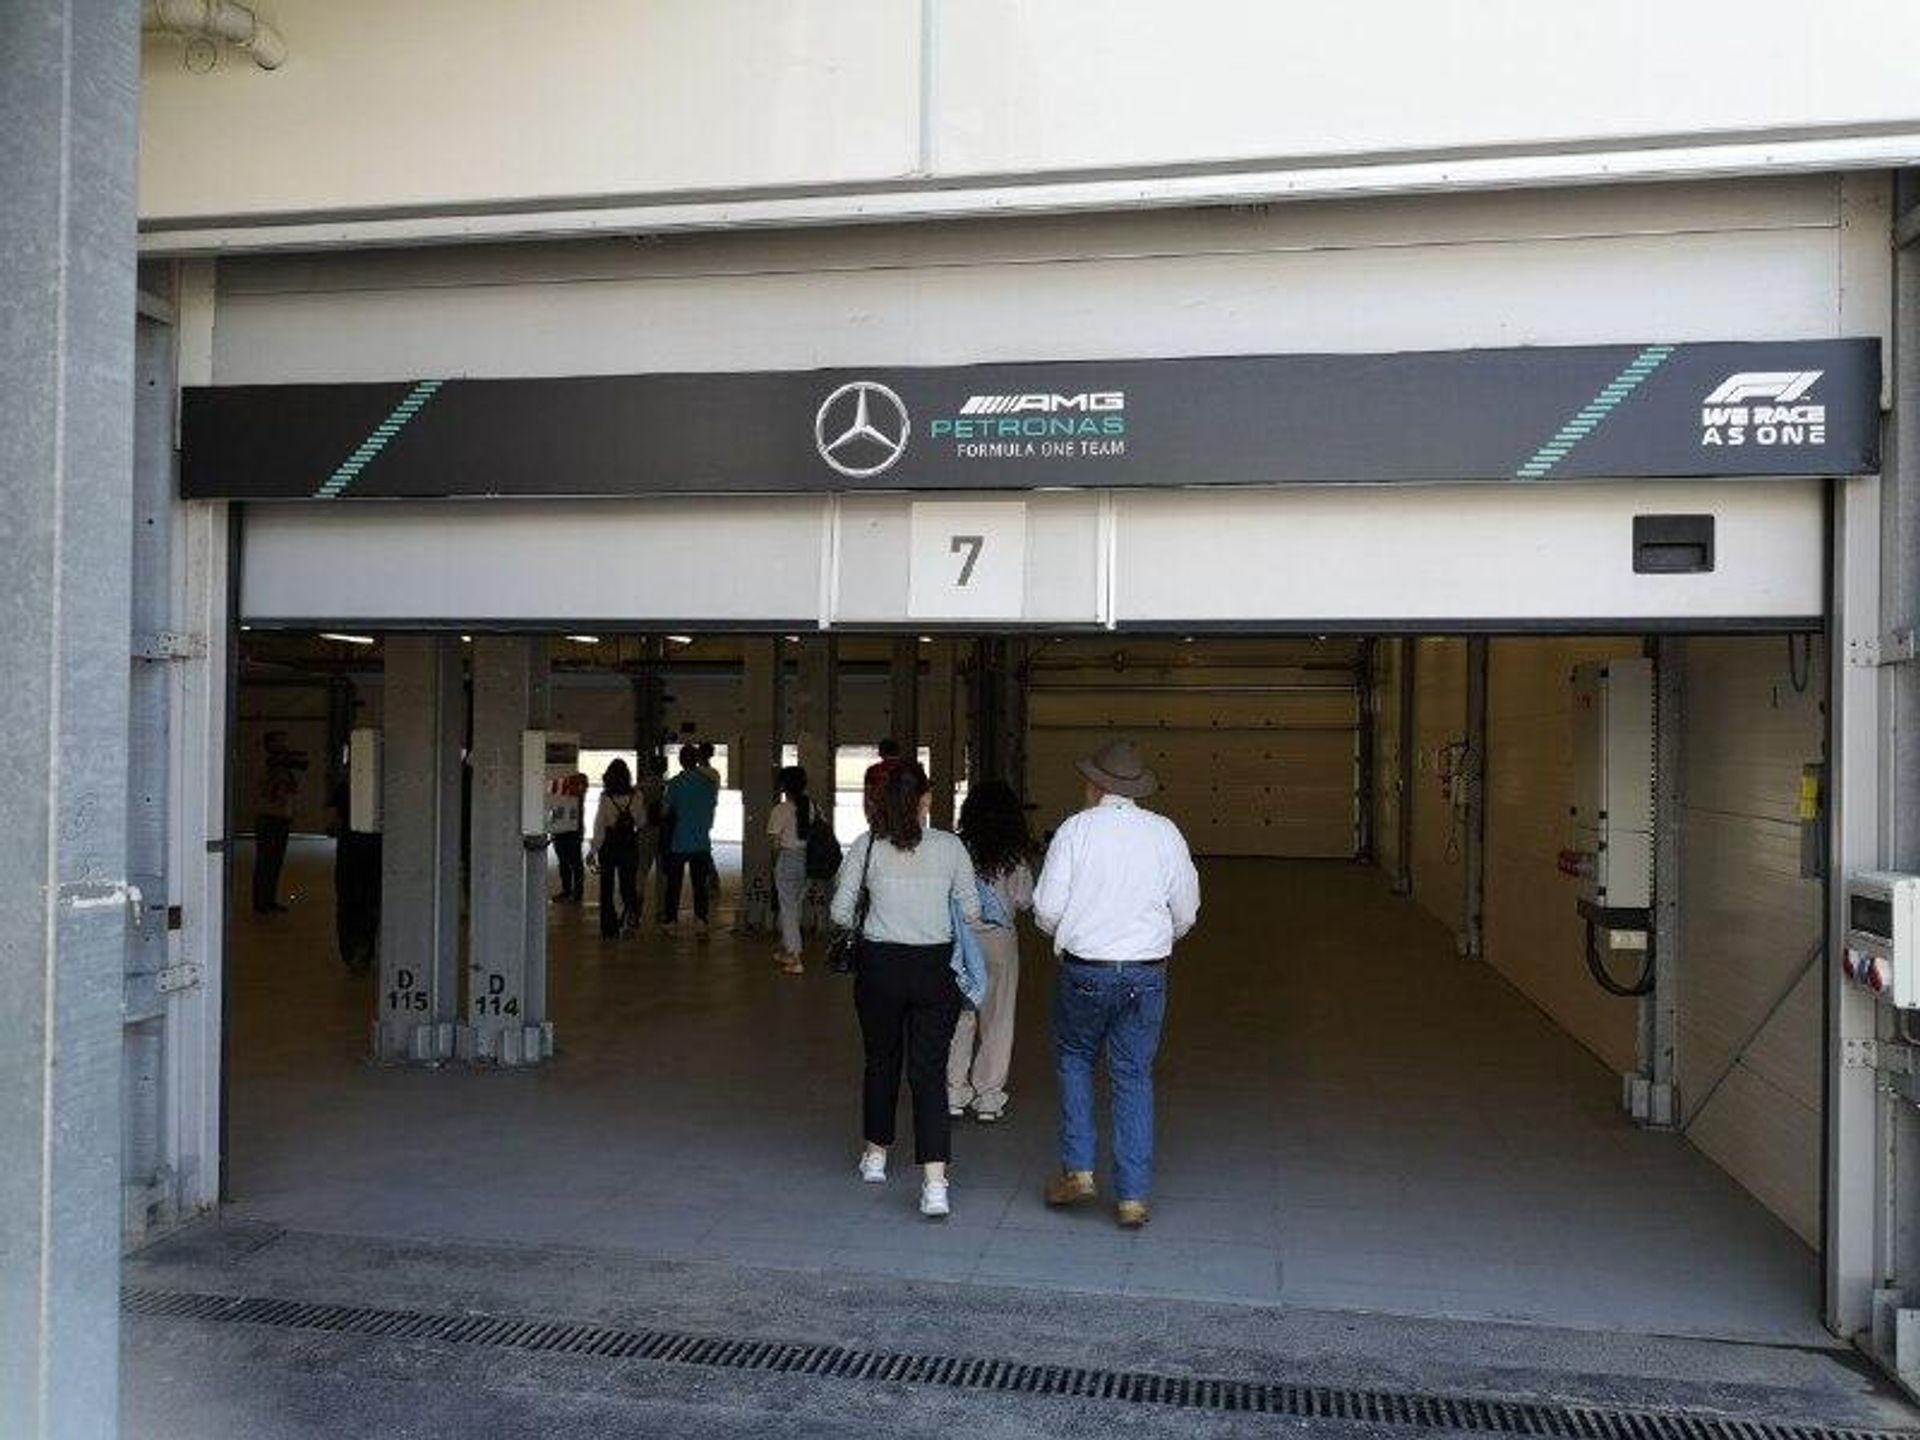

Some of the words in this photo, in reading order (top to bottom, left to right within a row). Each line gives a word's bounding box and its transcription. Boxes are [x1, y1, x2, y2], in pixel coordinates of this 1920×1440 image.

[1011, 391, 1125, 413] AMG
[1703, 407, 1749, 426] WE
[1753, 405, 1825, 424] RACE
[930, 417, 1125, 438] PETRONAS
[1702, 426, 1745, 445] AS
[1756, 425, 1825, 445] ONE
[957, 442, 1036, 458] FORMULA
[1041, 442, 1074, 457] ONE
[1080, 440, 1125, 456] TEAM
[951, 535, 984, 587] 7
[398, 969, 414, 989] D
[489, 974, 504, 995] D
[388, 991, 428, 1011] 115
[475, 996, 520, 1016] 114
